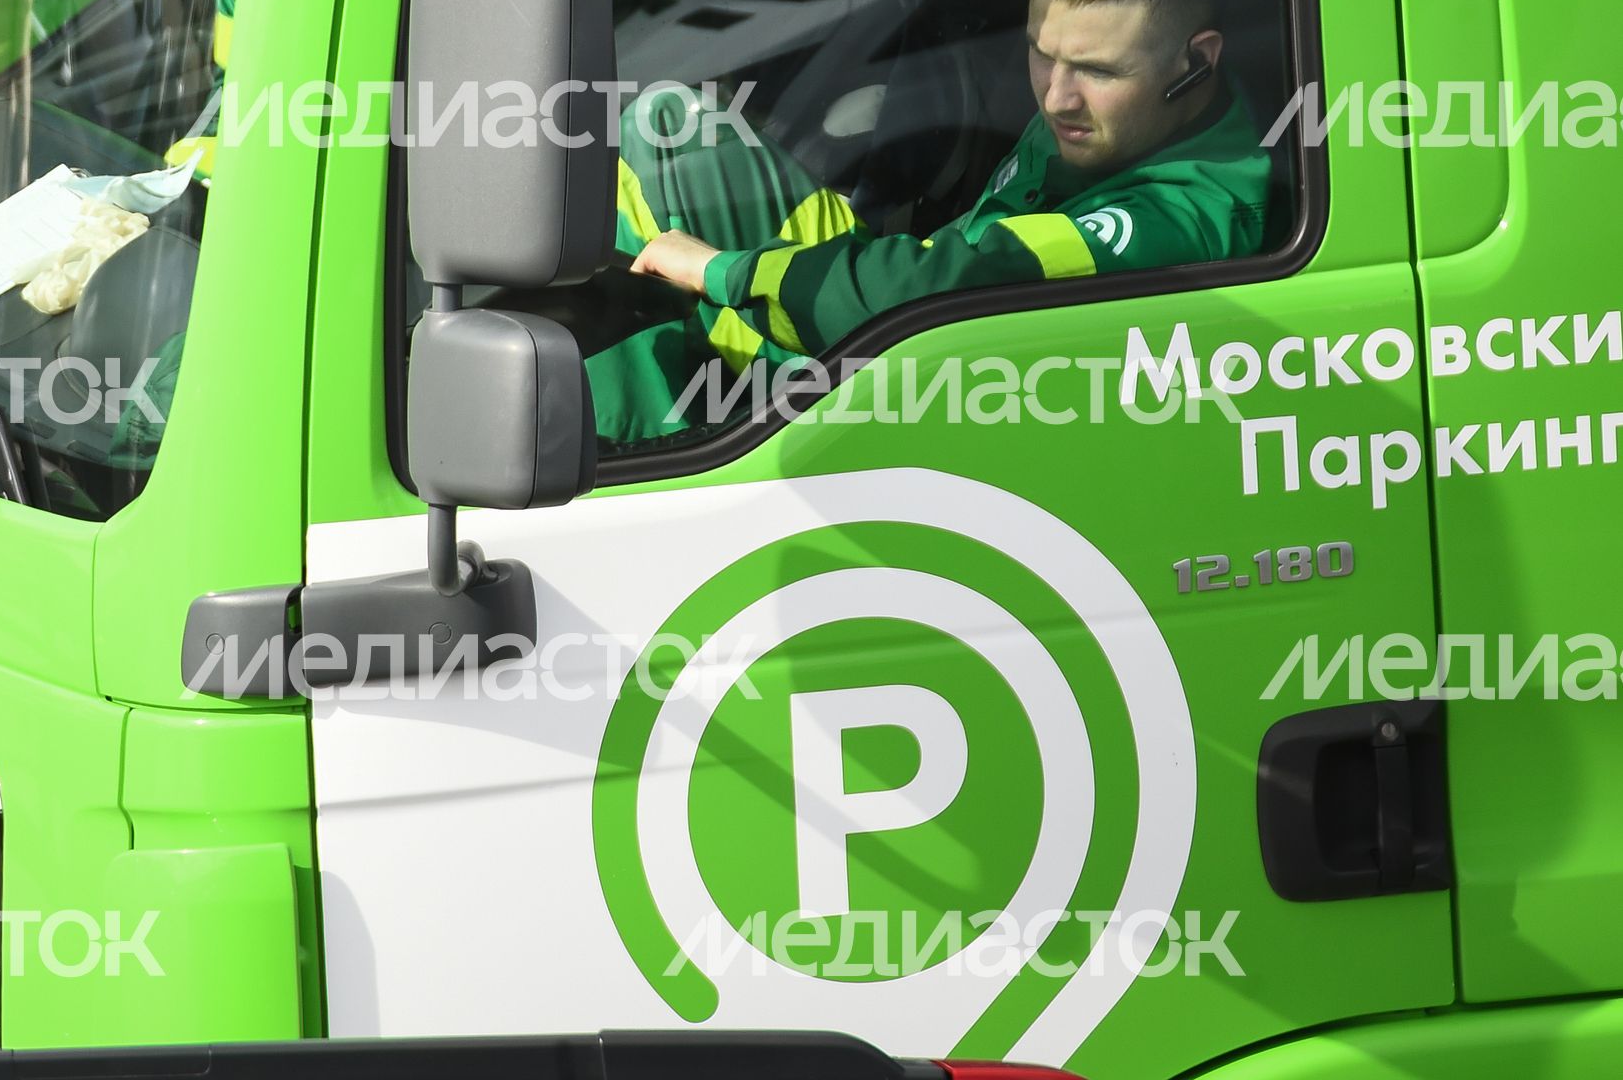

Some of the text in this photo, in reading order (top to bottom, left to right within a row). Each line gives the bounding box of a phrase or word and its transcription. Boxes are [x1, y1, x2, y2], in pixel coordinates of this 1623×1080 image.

[1119, 310, 1623, 406] Московски
[1172, 541, 1355, 593] 12.180
[789, 683, 970, 920] P
